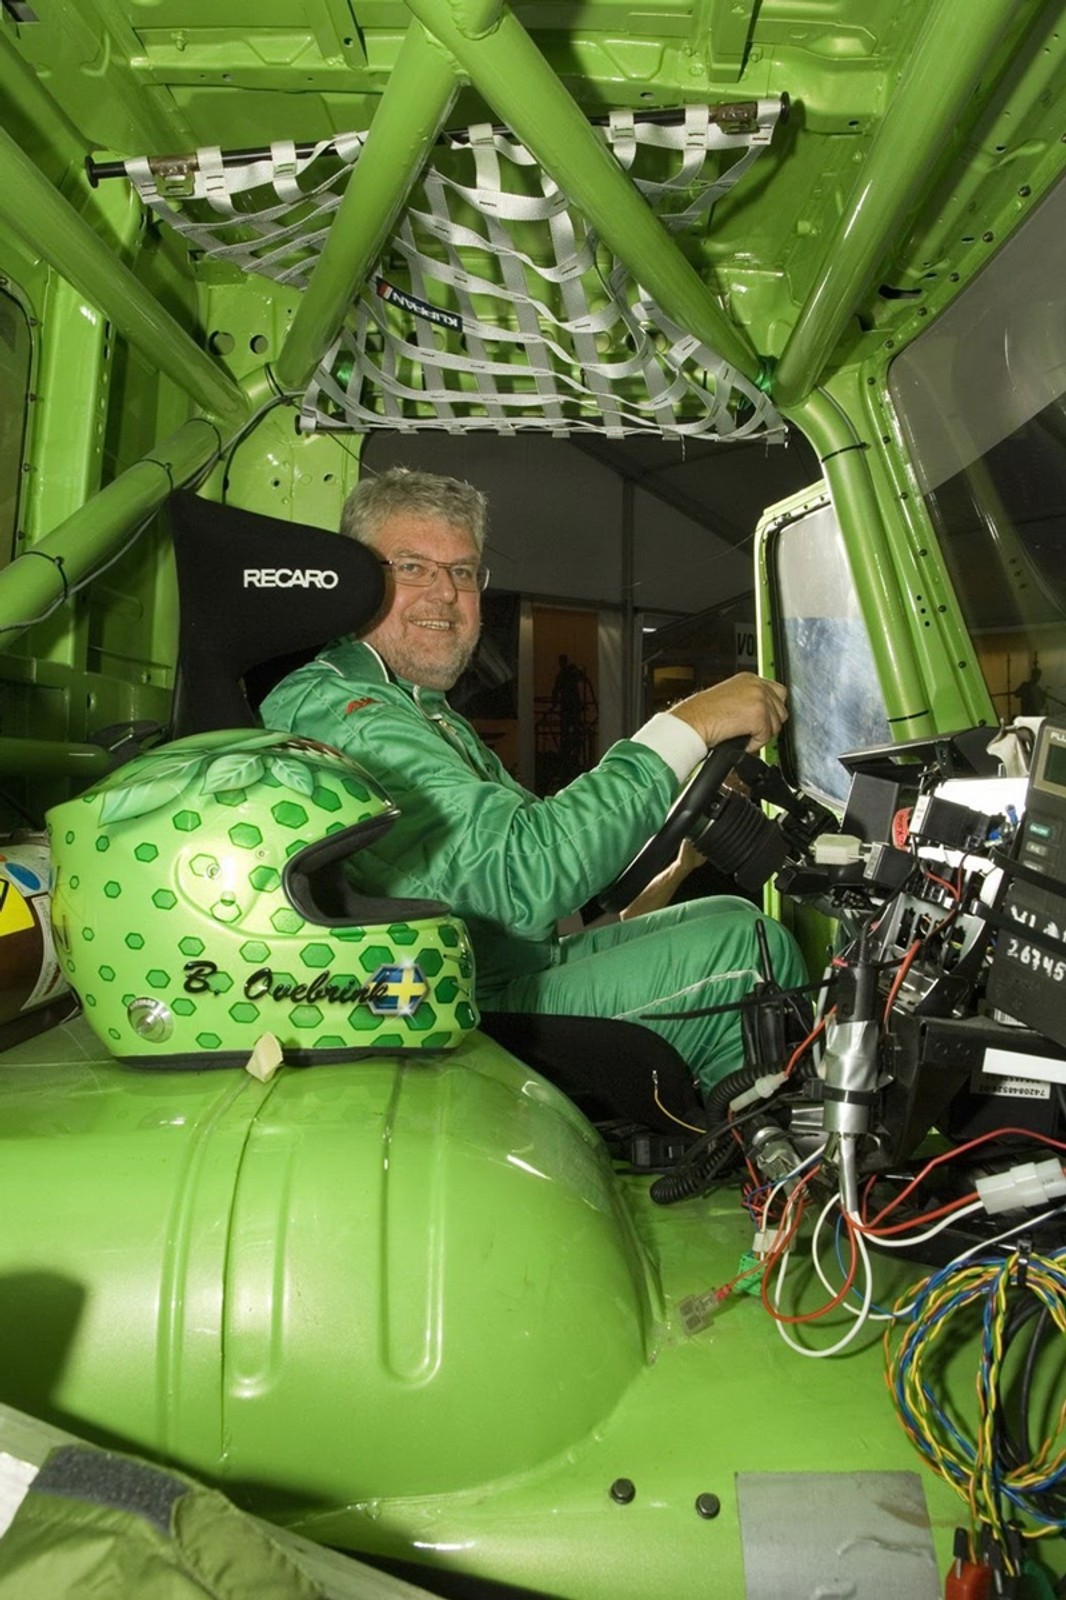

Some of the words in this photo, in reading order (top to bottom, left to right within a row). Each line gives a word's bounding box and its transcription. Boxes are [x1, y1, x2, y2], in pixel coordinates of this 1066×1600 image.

[392, 291, 458, 328] KLIPPAN
[243, 568, 339, 590] RECARO
[1006, 938, 1066, 982] 26745
[183, 960, 221, 996] B.
[243, 967, 389, 1005] Ovebrink
